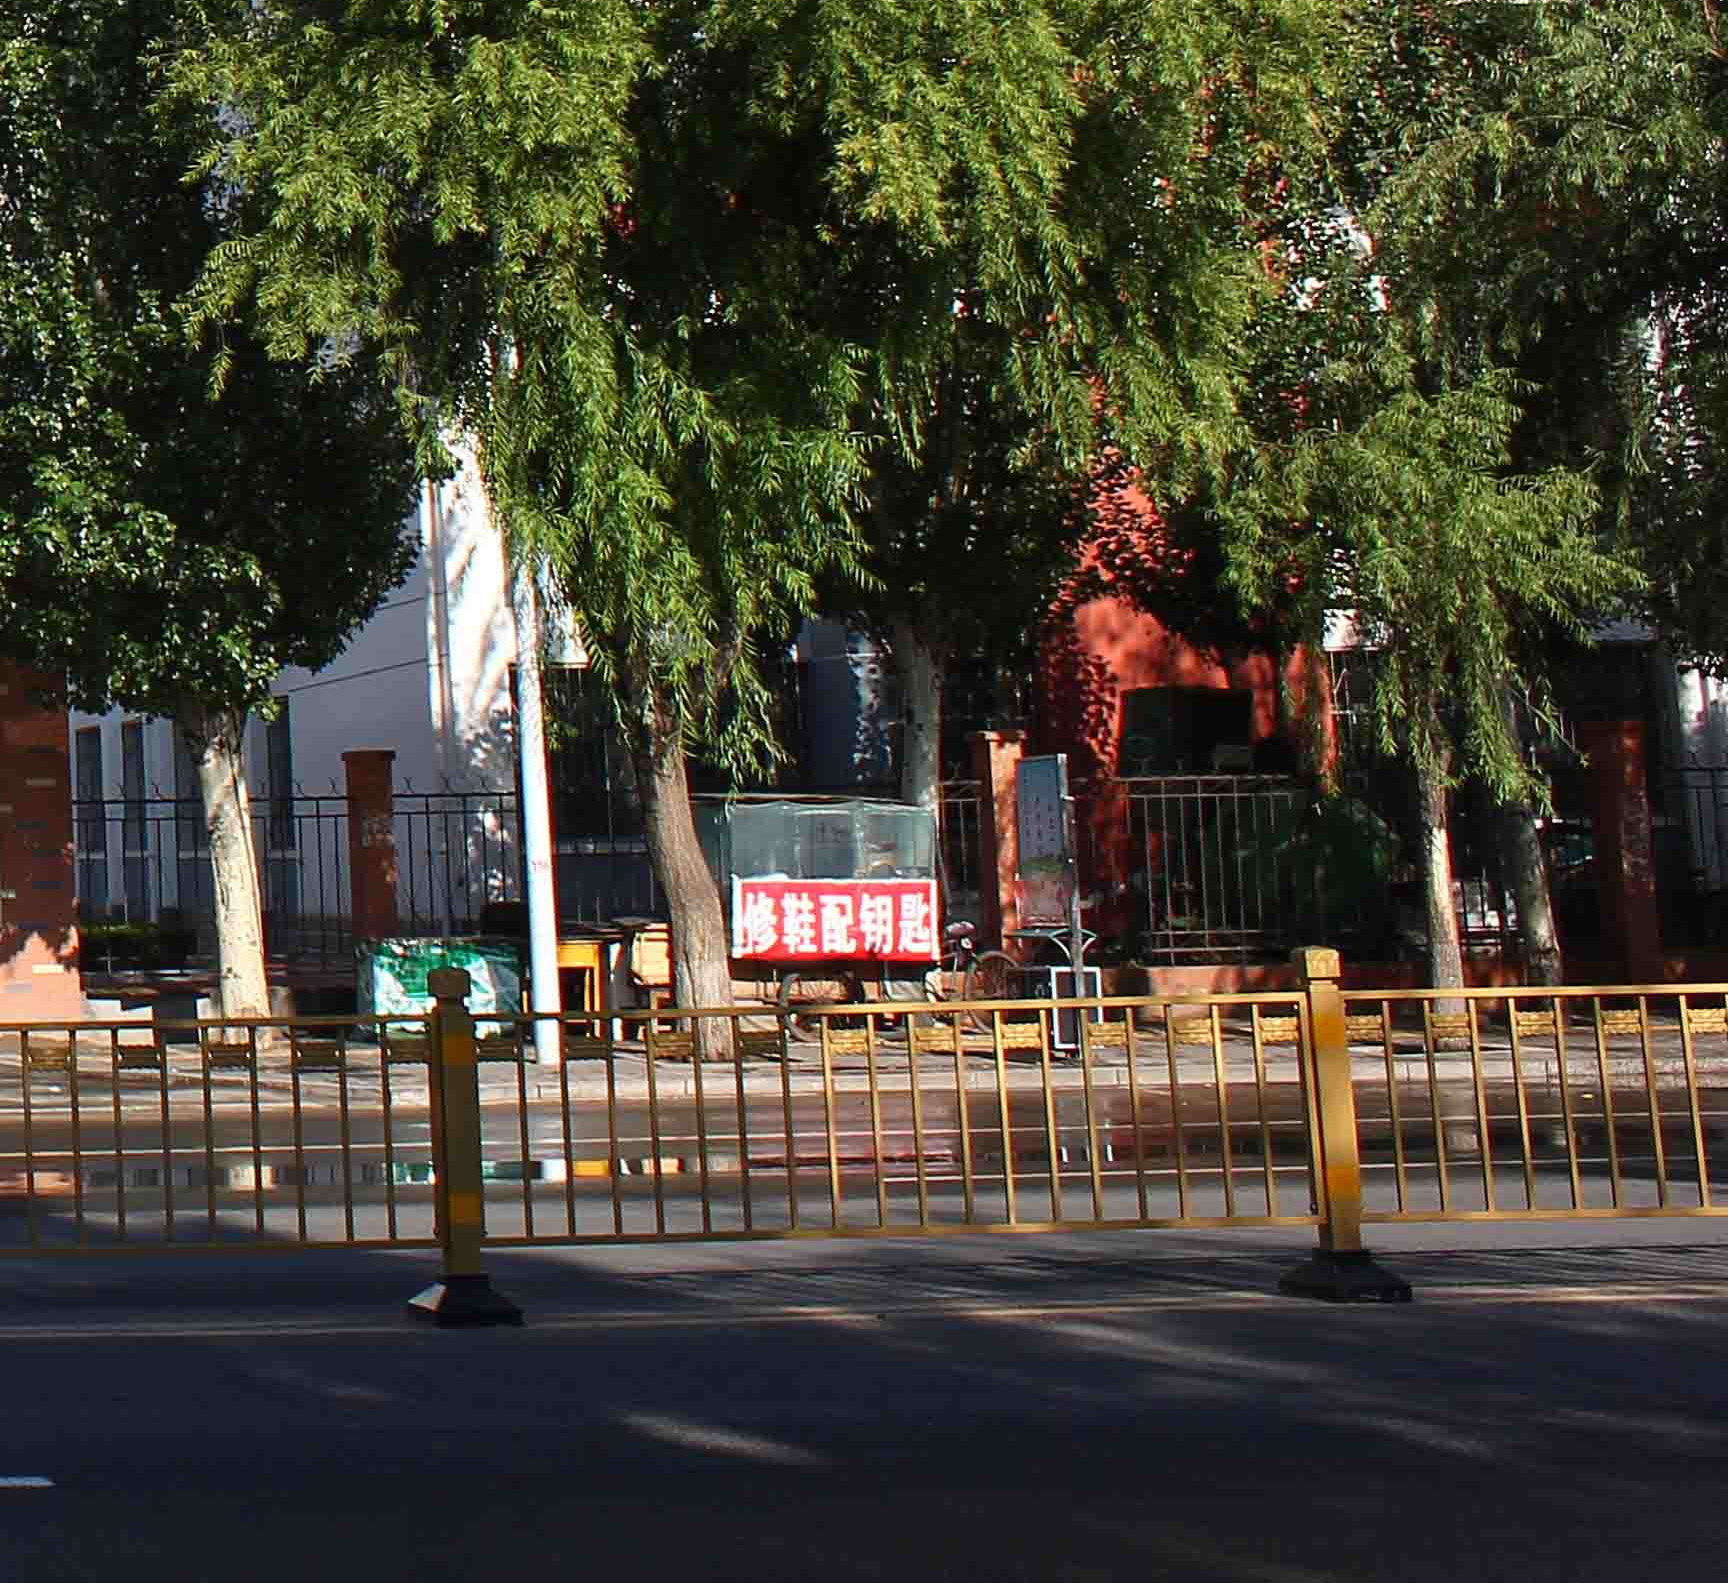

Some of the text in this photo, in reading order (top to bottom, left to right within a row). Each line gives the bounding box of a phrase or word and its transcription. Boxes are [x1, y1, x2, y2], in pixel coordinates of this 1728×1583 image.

[738, 891, 932, 955] 修鞋配钥匙
